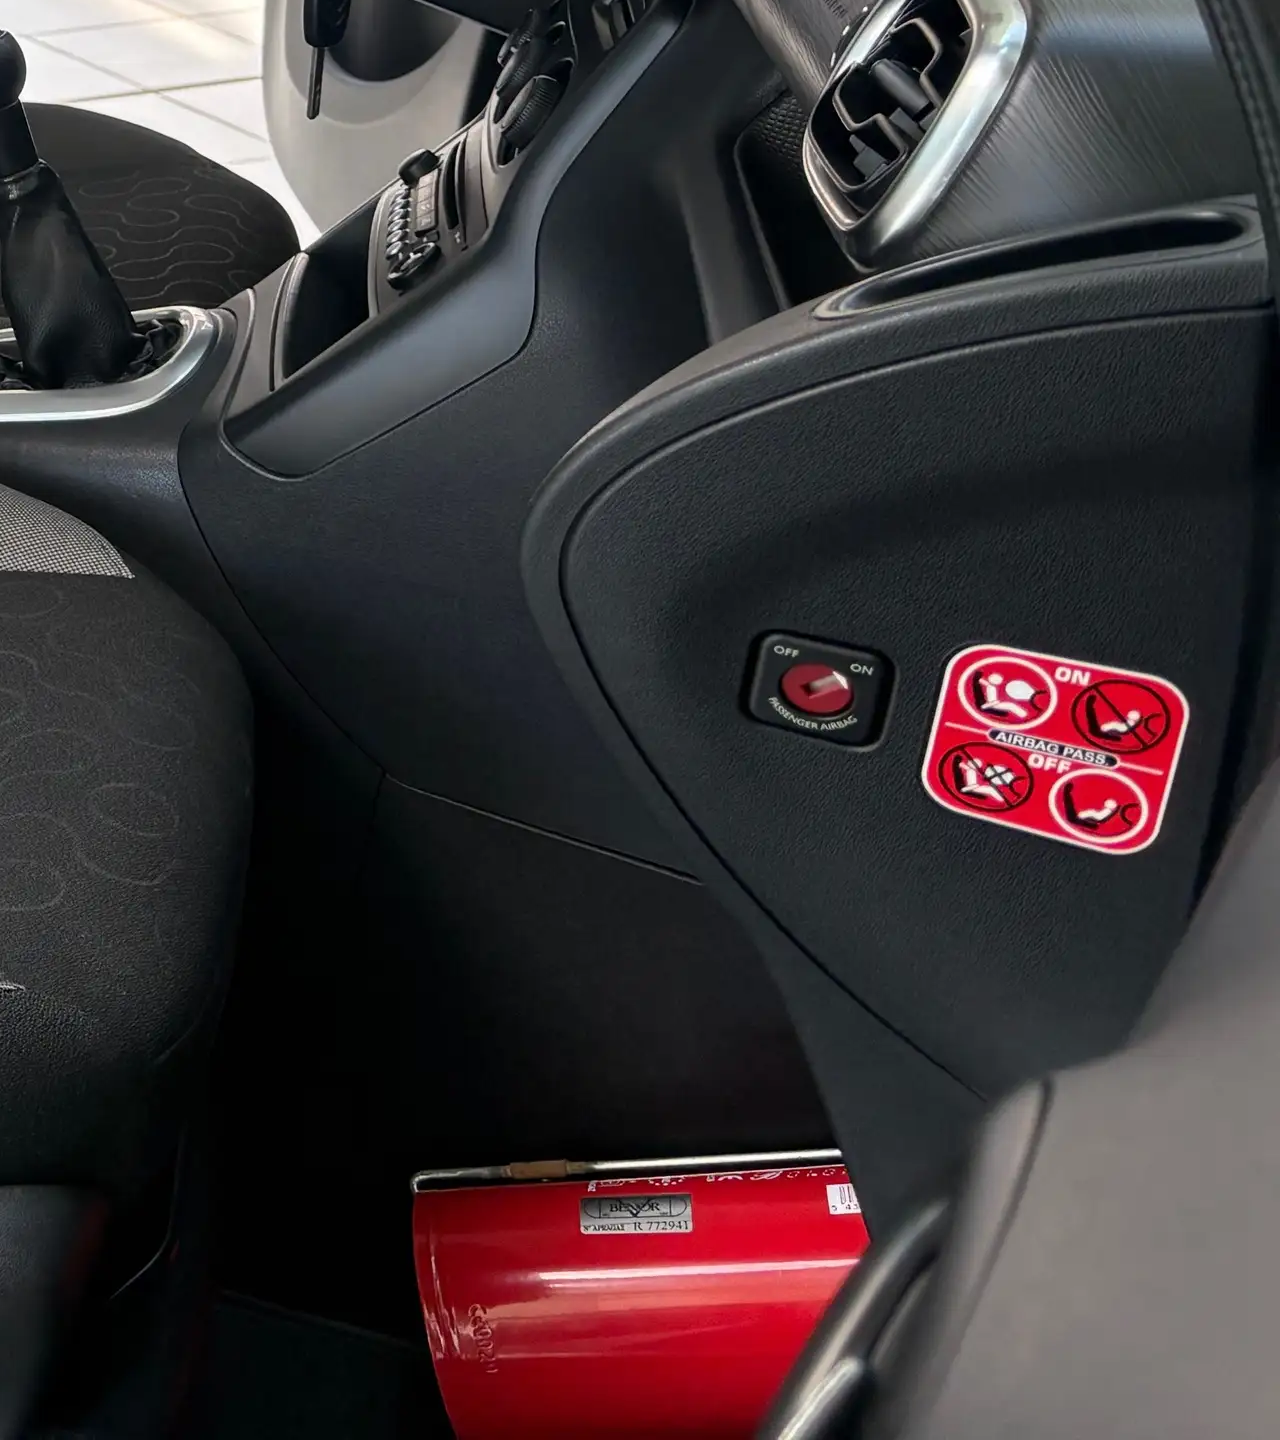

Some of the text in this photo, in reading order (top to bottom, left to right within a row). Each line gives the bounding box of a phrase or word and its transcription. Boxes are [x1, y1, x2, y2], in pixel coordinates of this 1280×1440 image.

[773, 645, 800, 658] OFF
[850, 663, 874, 676] ON
[1054, 666, 1091, 686] ON
[768, 696, 858, 731] PASSENGER AIRBAG
[995, 731, 1109, 767] AIRBAG PASS.
[1028, 753, 1072, 774] OFF
